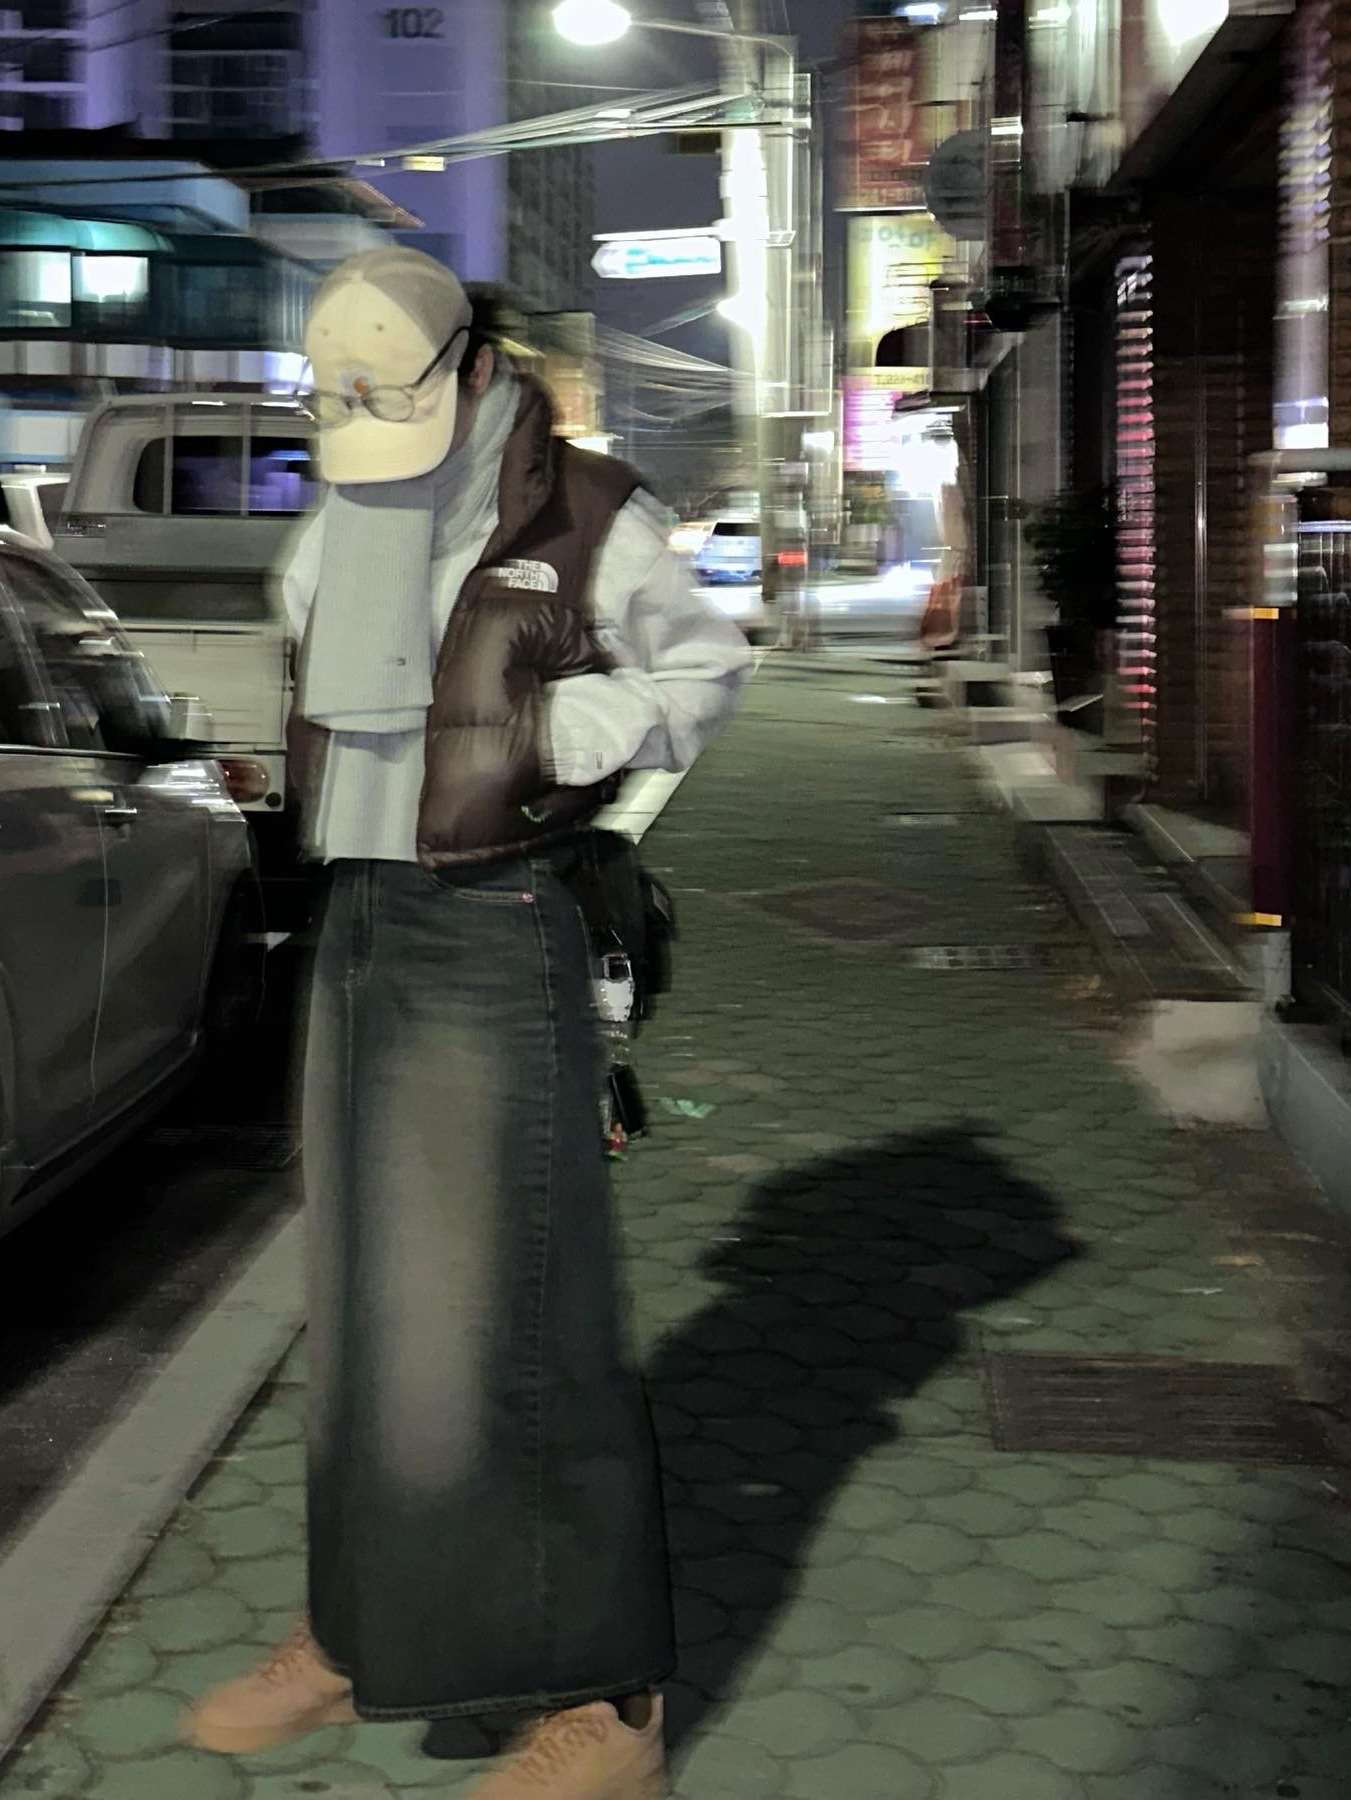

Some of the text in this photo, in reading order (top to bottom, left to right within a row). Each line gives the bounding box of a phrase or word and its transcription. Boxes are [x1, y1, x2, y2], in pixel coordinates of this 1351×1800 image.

[382, 8, 446, 39] 102
[517, 560, 542, 570] THE
[498, 567, 540, 580] NORTH
[508, 578, 539, 589] FACE
